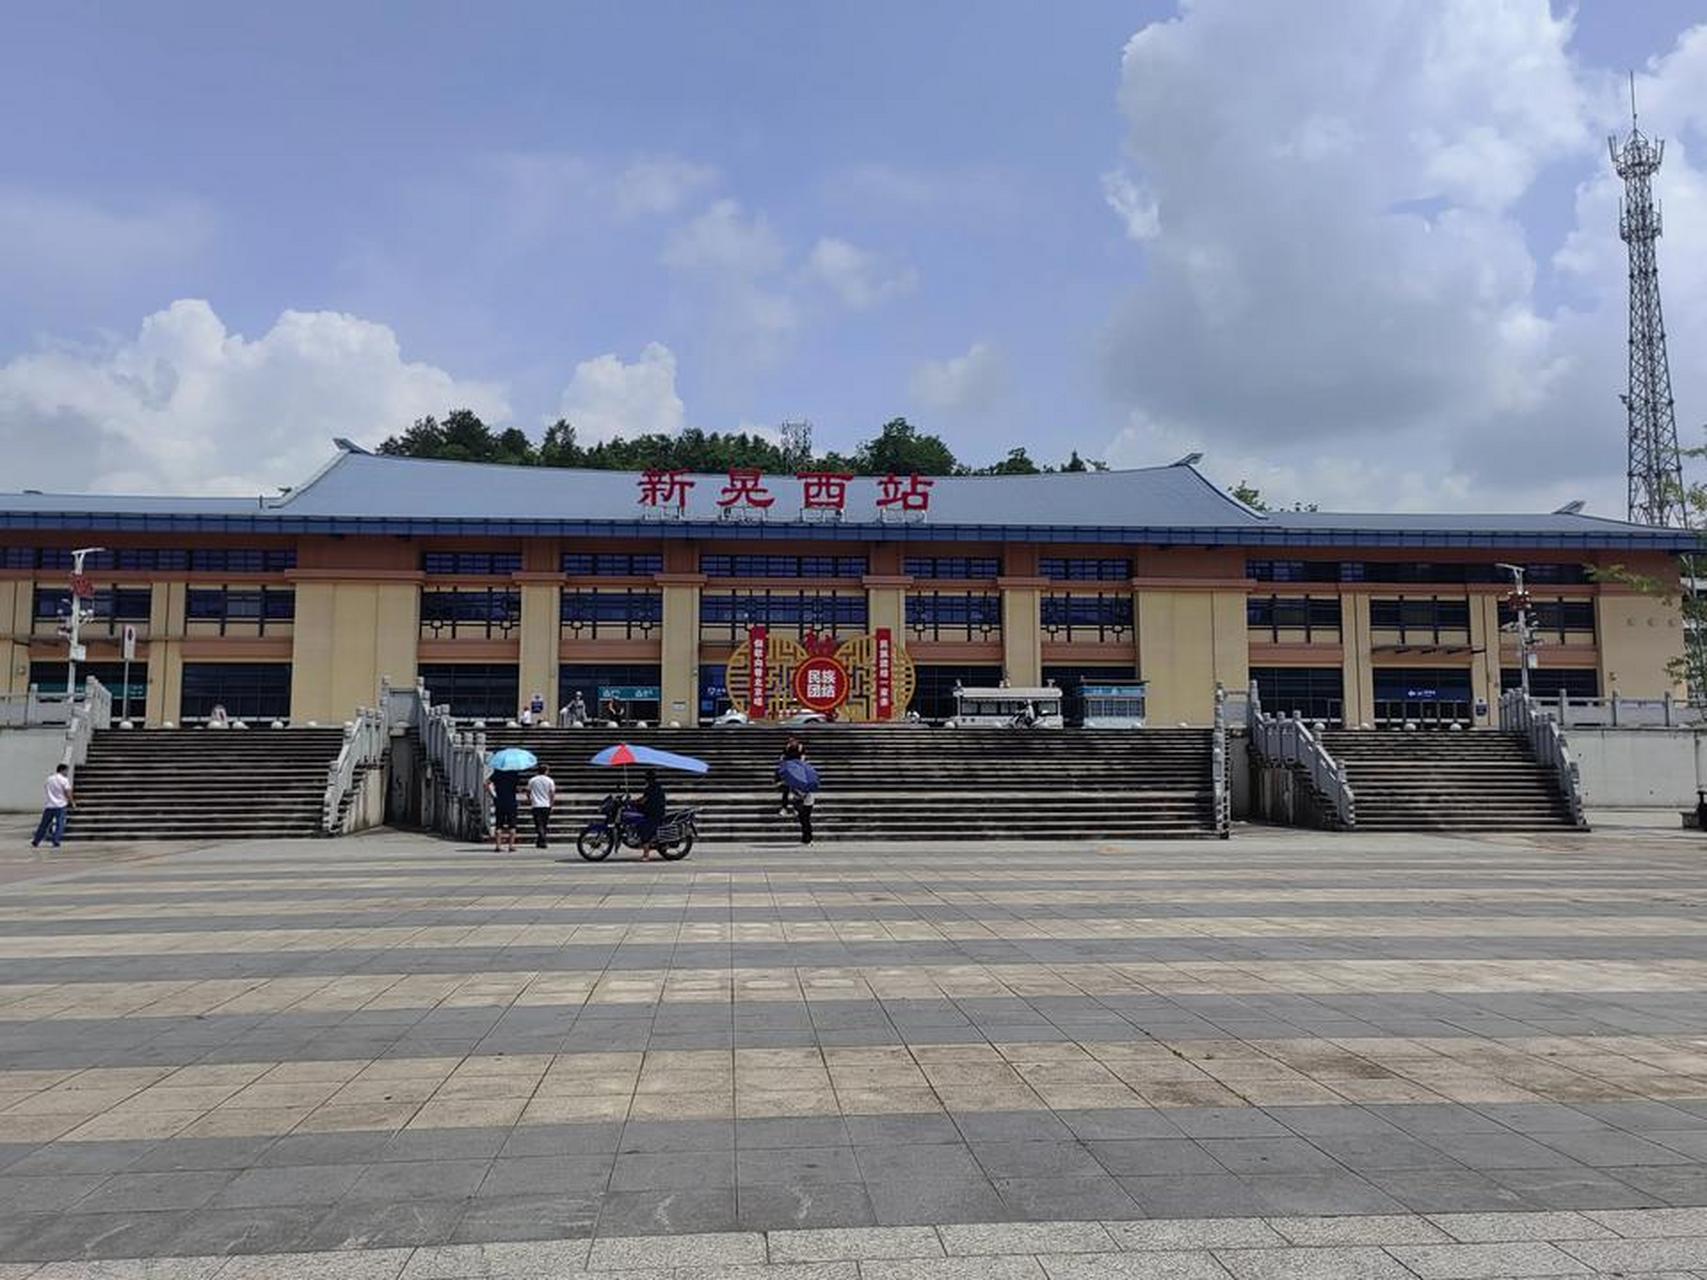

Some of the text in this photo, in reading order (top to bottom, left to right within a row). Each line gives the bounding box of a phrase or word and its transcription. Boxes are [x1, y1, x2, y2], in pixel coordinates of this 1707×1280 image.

[636, 467, 934, 511] 新晃西站
[807, 669, 836, 684] 民族
[807, 684, 836, 698] 团结
